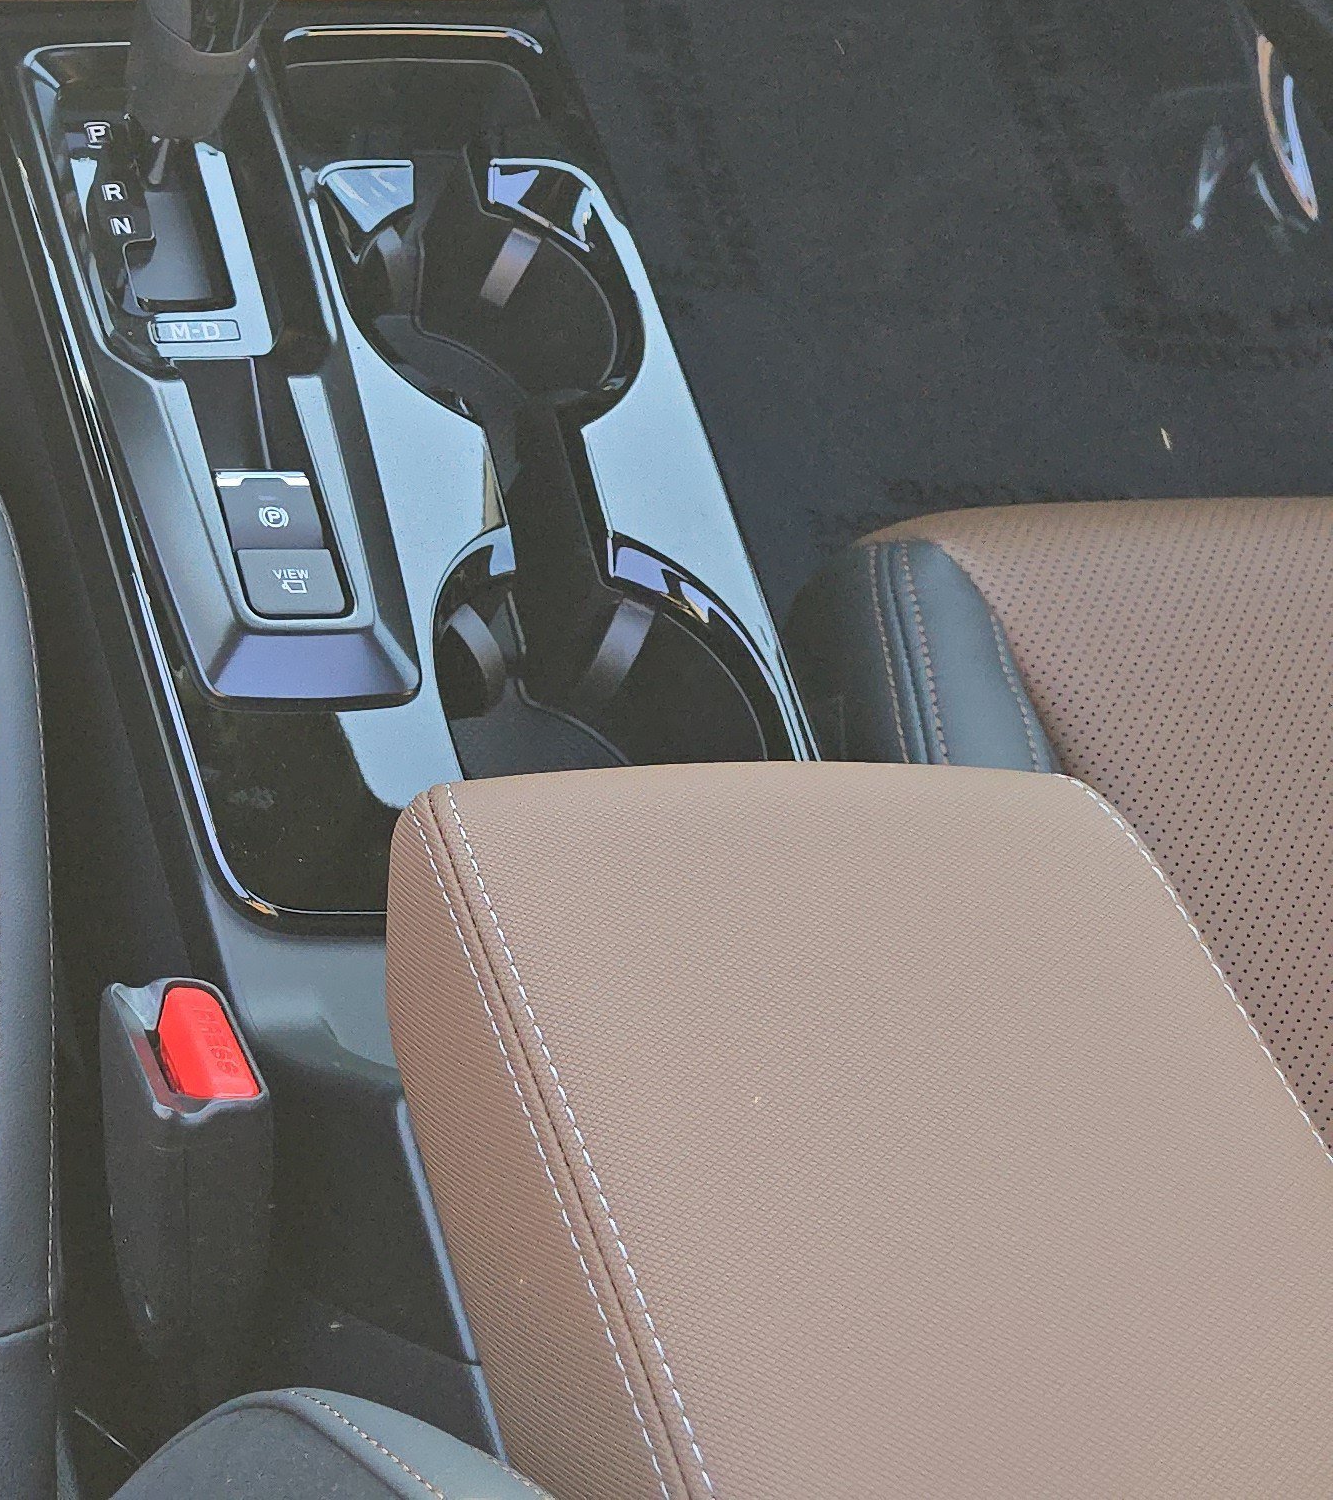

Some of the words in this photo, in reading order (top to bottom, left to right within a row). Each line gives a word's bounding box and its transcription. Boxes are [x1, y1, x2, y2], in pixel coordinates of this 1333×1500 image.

[88, 124, 106, 138] P
[104, 183, 123, 200] R
[111, 218, 132, 235] N
[272, 569, 309, 579] VIEW
